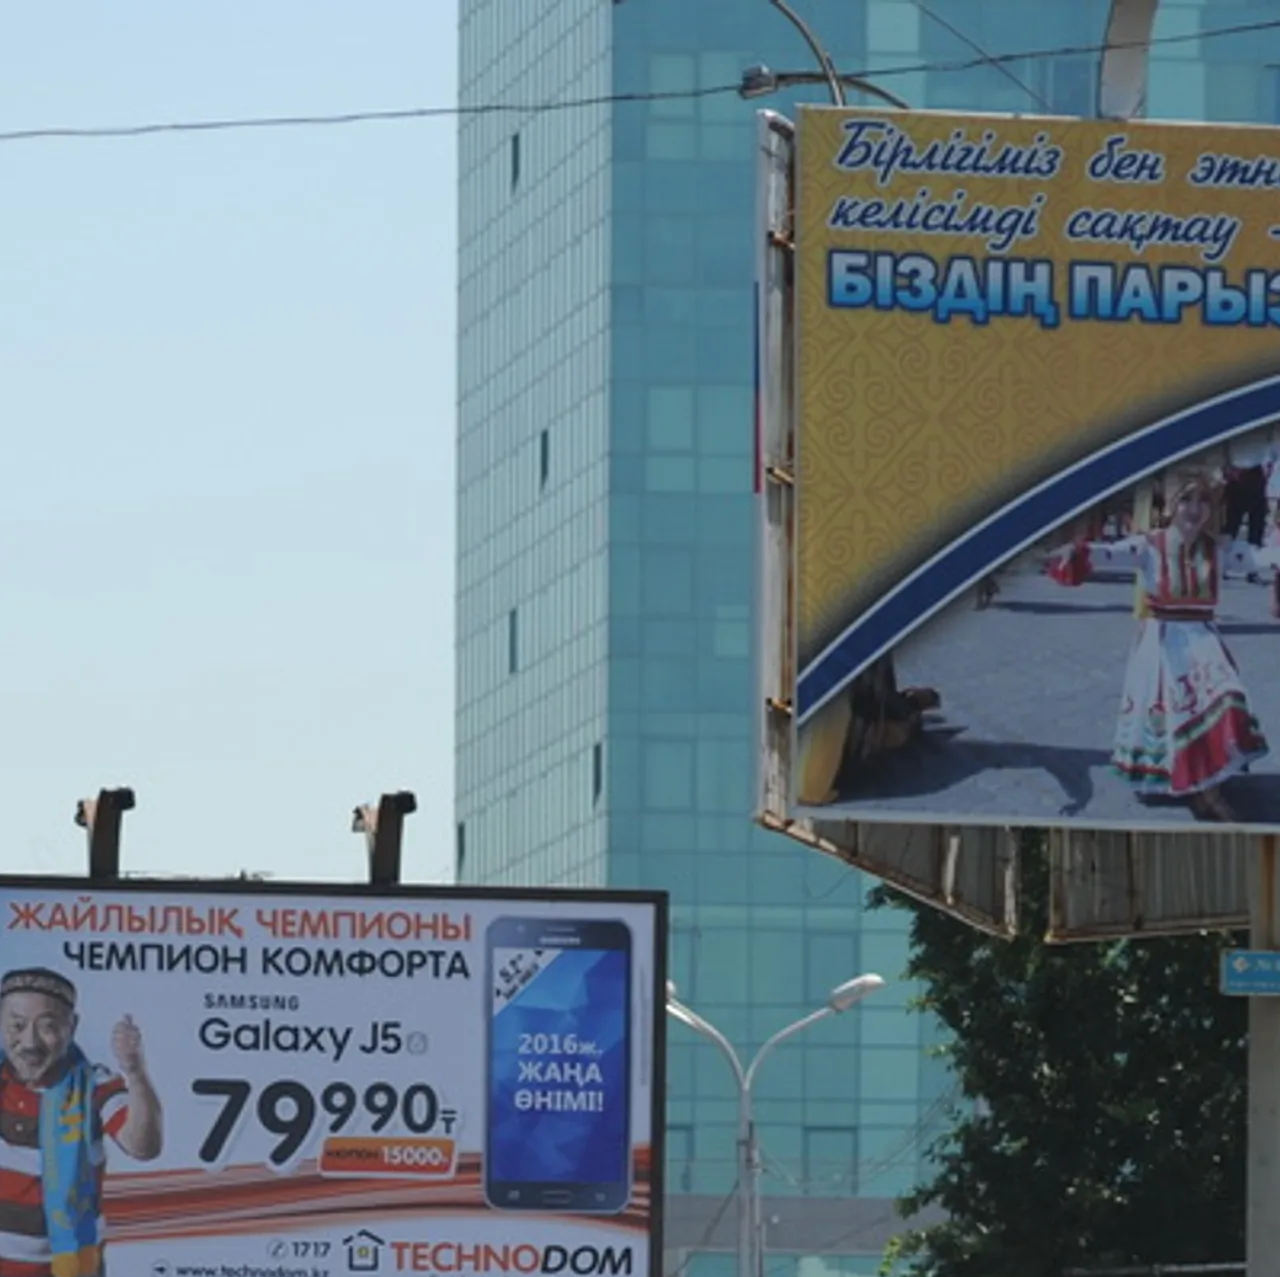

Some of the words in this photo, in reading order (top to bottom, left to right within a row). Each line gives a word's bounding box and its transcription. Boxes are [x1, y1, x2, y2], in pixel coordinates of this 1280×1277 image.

[837, 120, 1061, 184] Бірлігіміз
[1089, 136, 1163, 181] бен
[829, 190, 1042, 251] келісімді
[1067, 207, 1239, 260] сақтау
[828, 249, 1060, 328] БІЗДІҢ
[7, 897, 244, 939] ЖАЙЛЫЛЫҚ
[256, 908, 471, 941] ЧЕМПИОНЫ
[63, 941, 247, 975] ЧЕМПИОН
[262, 947, 471, 979] КОМФОРТА
[204, 992, 300, 1011] SAMSUNG
[198, 1018, 354, 1062] Galaxy
[518, 1062, 602, 1088] ЖАҢА
[514, 1090, 604, 1112] ӨНІМІ!
[292, 1241, 331, 1258] 1717
[390, 1240, 634, 1276] TECHNODOM
